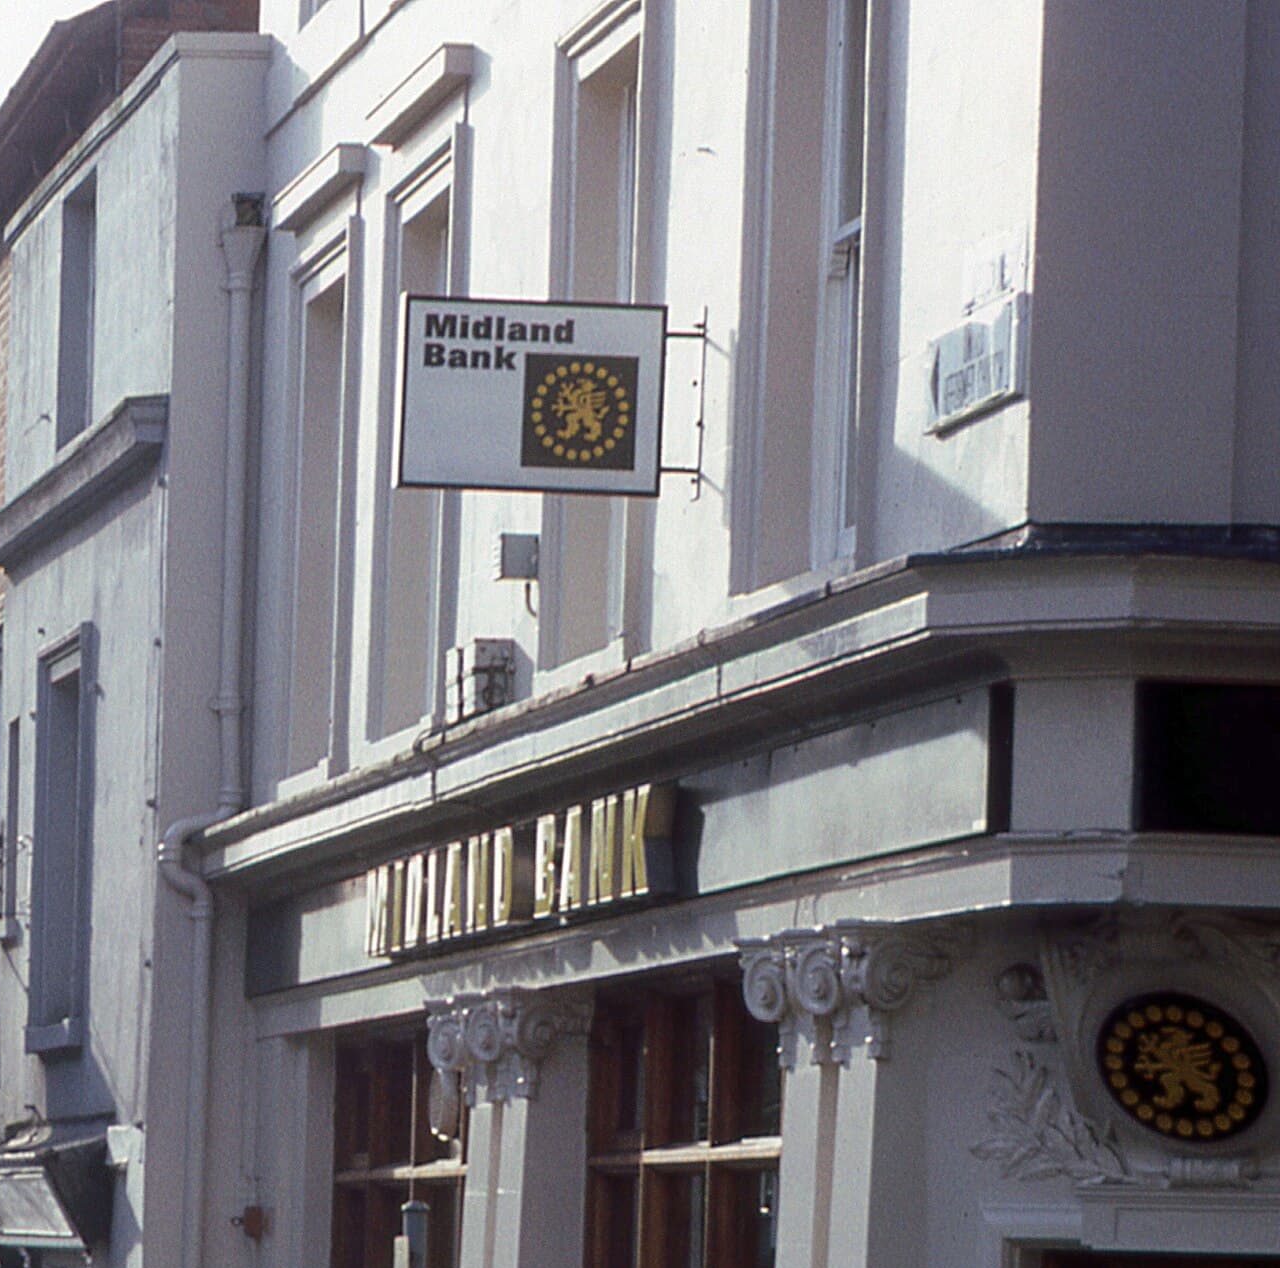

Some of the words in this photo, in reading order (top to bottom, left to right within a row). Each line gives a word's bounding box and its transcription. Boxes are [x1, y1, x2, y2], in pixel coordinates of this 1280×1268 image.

[423, 343, 517, 371] Bank
[424, 313, 575, 343] Midland
[364, 826, 513, 957] MIDLAND
[533, 784, 651, 919] BANK
